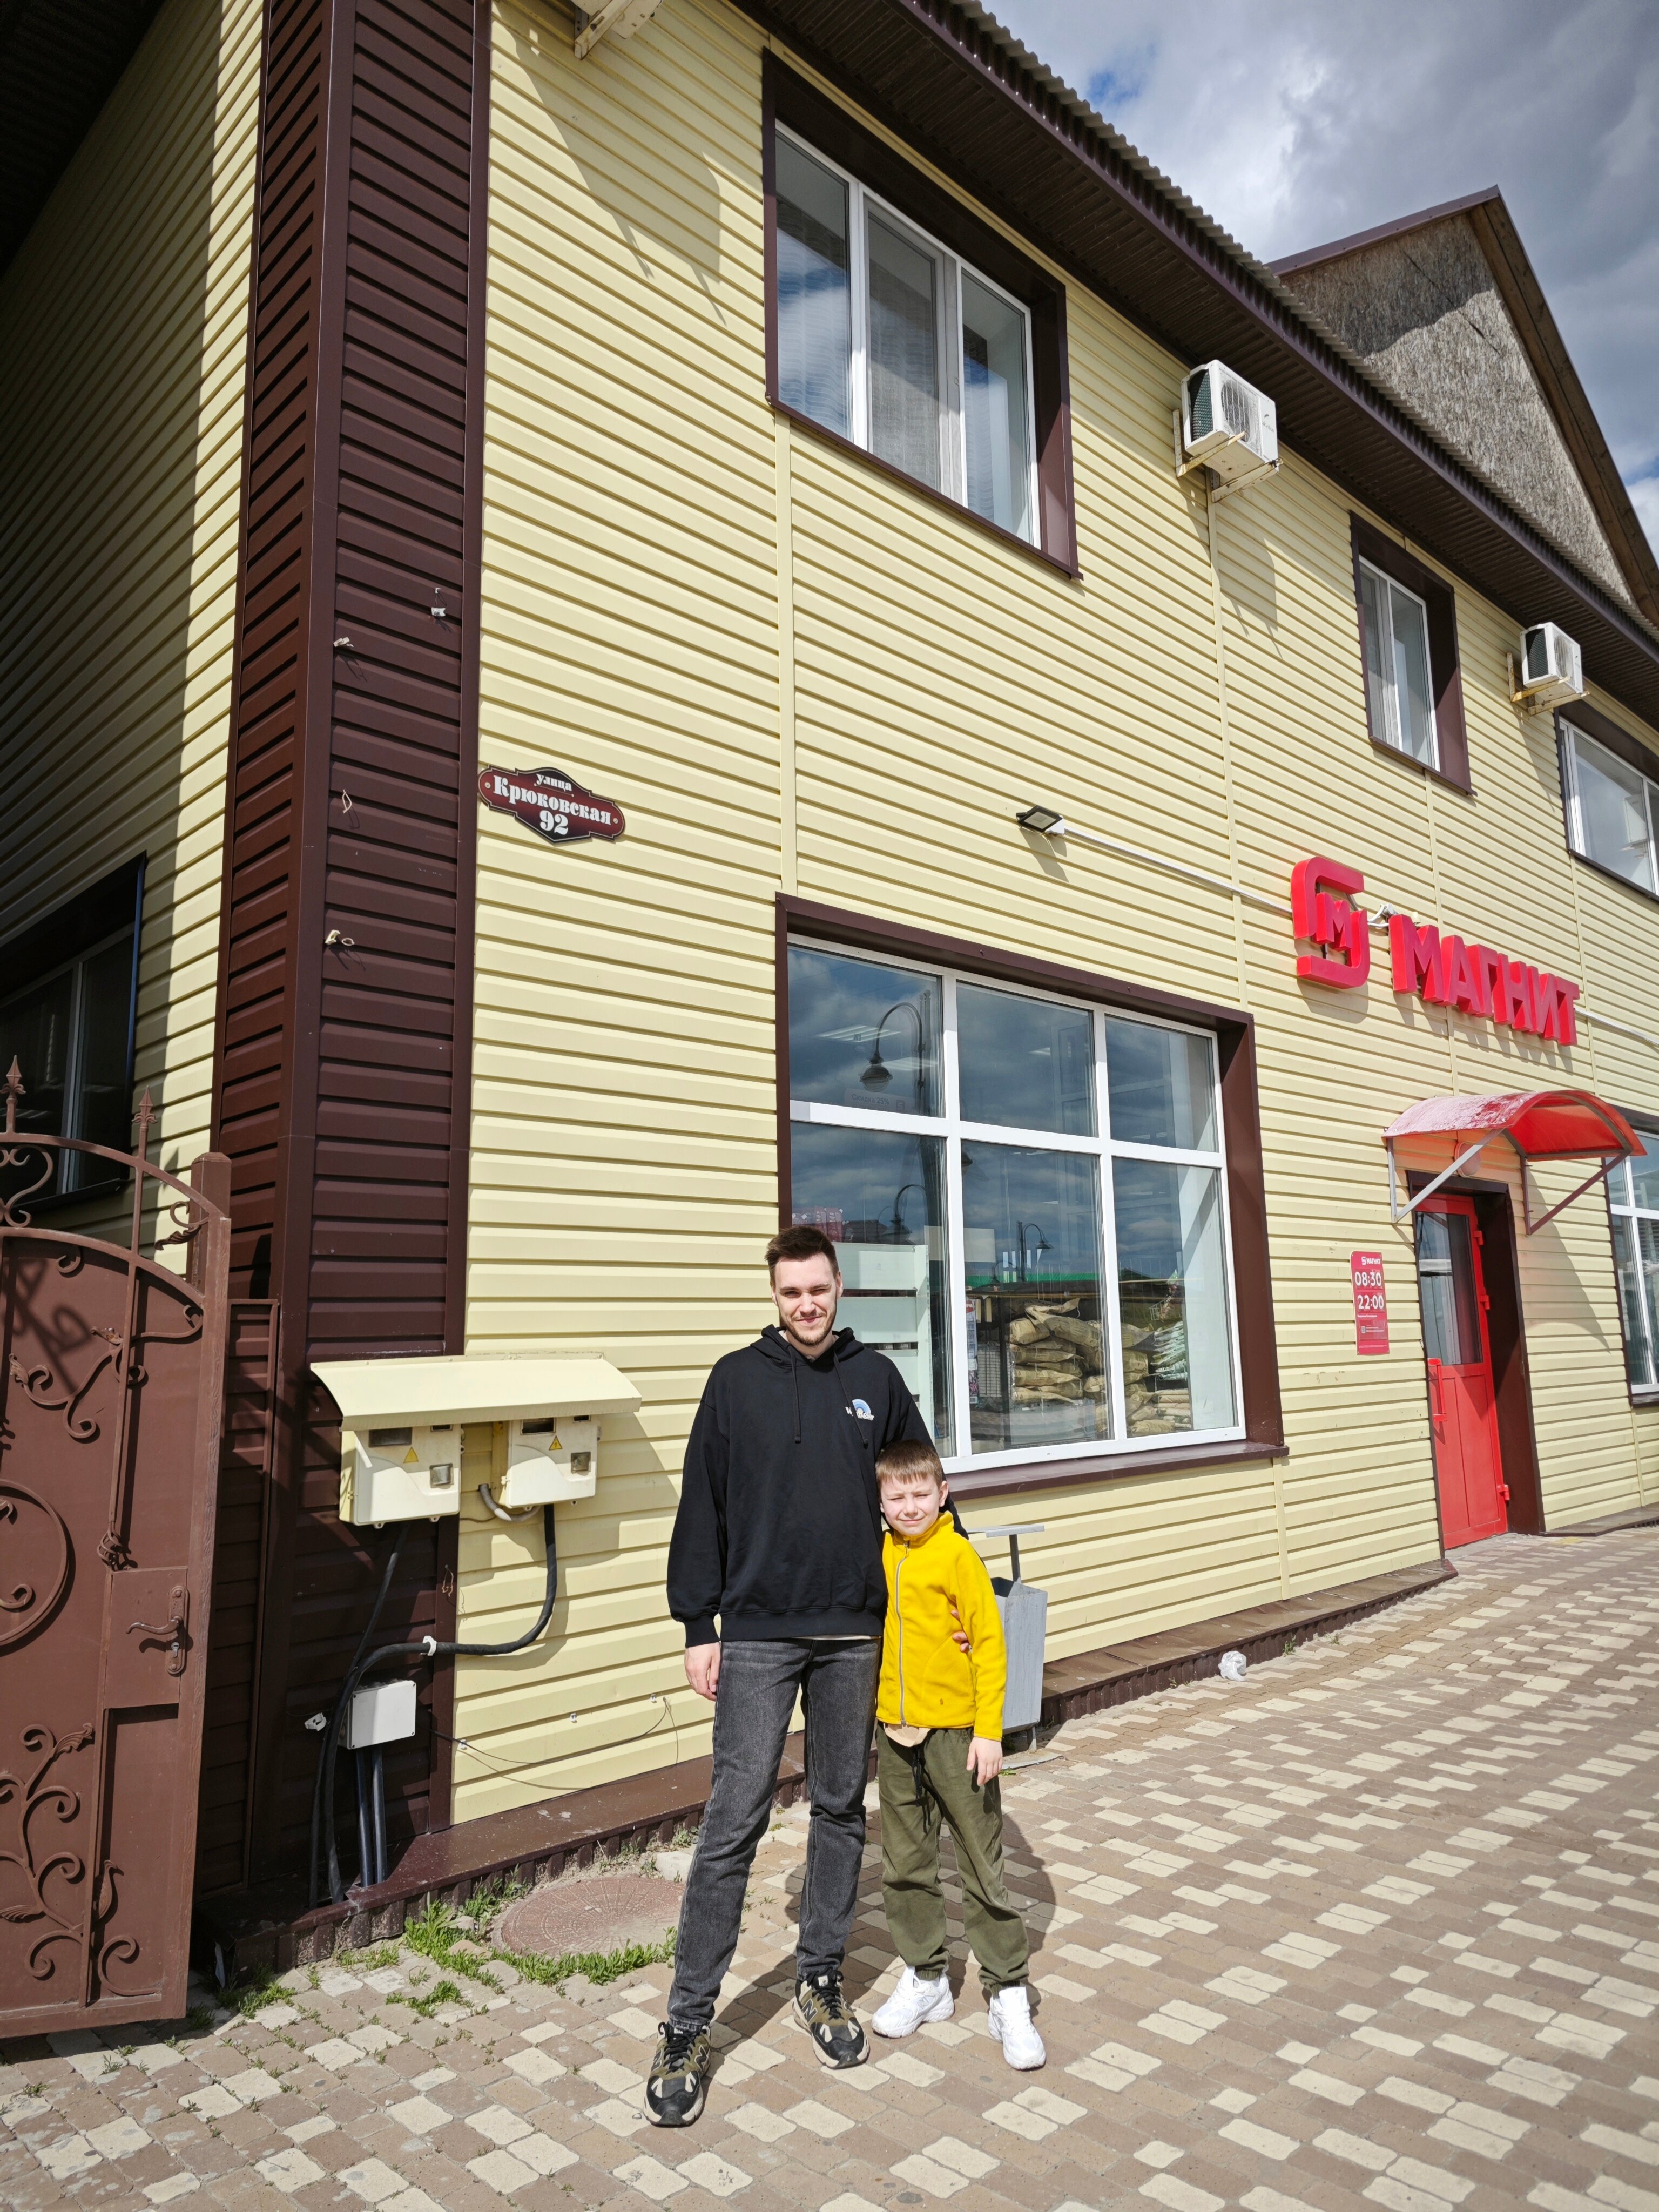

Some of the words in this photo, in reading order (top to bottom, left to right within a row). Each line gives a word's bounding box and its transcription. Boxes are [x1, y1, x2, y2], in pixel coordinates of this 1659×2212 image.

[536, 773, 572, 792] улица
[493, 775, 611, 825] Крюковская
[539, 810, 569, 835] 92
[1388, 914, 1580, 1047] МАГНИТ
[852, 1094, 875, 1103] Скидка
[877, 1097, 890, 1105] 25%
[1355, 1271, 1382, 1286] 08:30
[1358, 1294, 1384, 1309] 22:00
